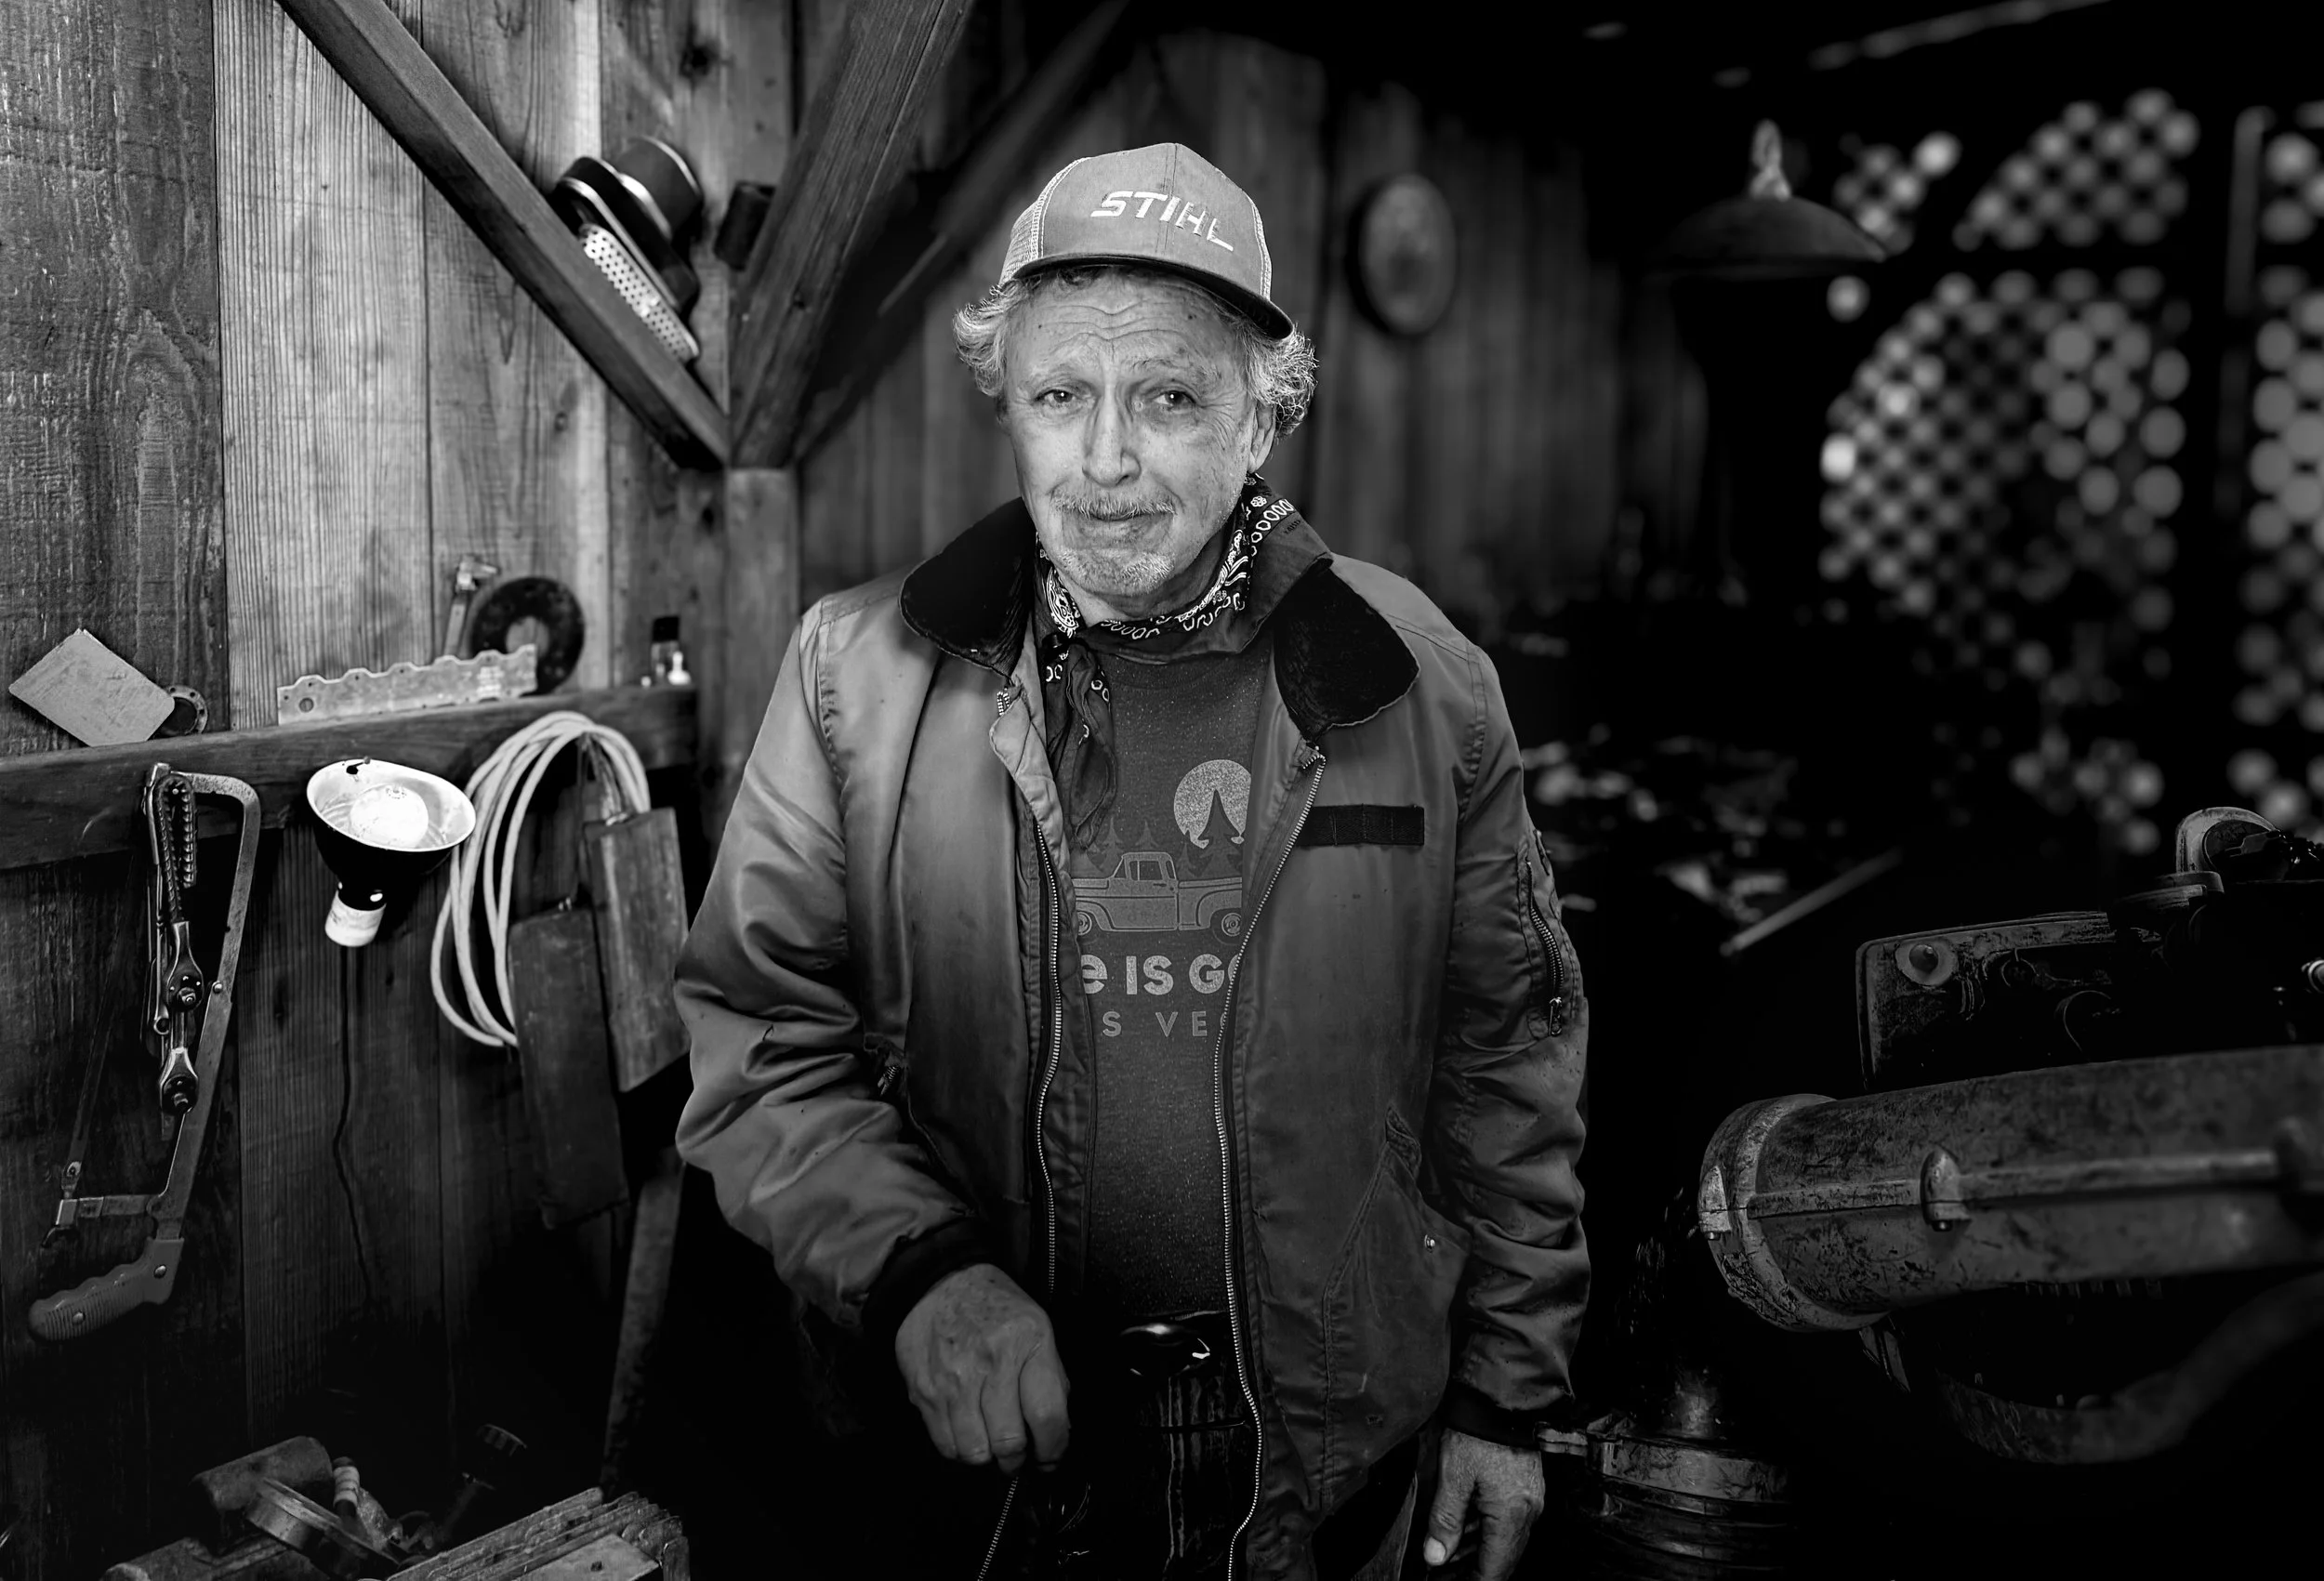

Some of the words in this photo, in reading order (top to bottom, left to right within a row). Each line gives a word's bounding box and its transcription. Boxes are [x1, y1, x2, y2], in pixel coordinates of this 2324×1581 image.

[1090, 191, 1235, 252] STIHL
[1126, 955, 1175, 995] IS
[1188, 954, 1240, 995] G
[1102, 1010, 1122, 1037] S
[1155, 1010, 1226, 1038] VE
